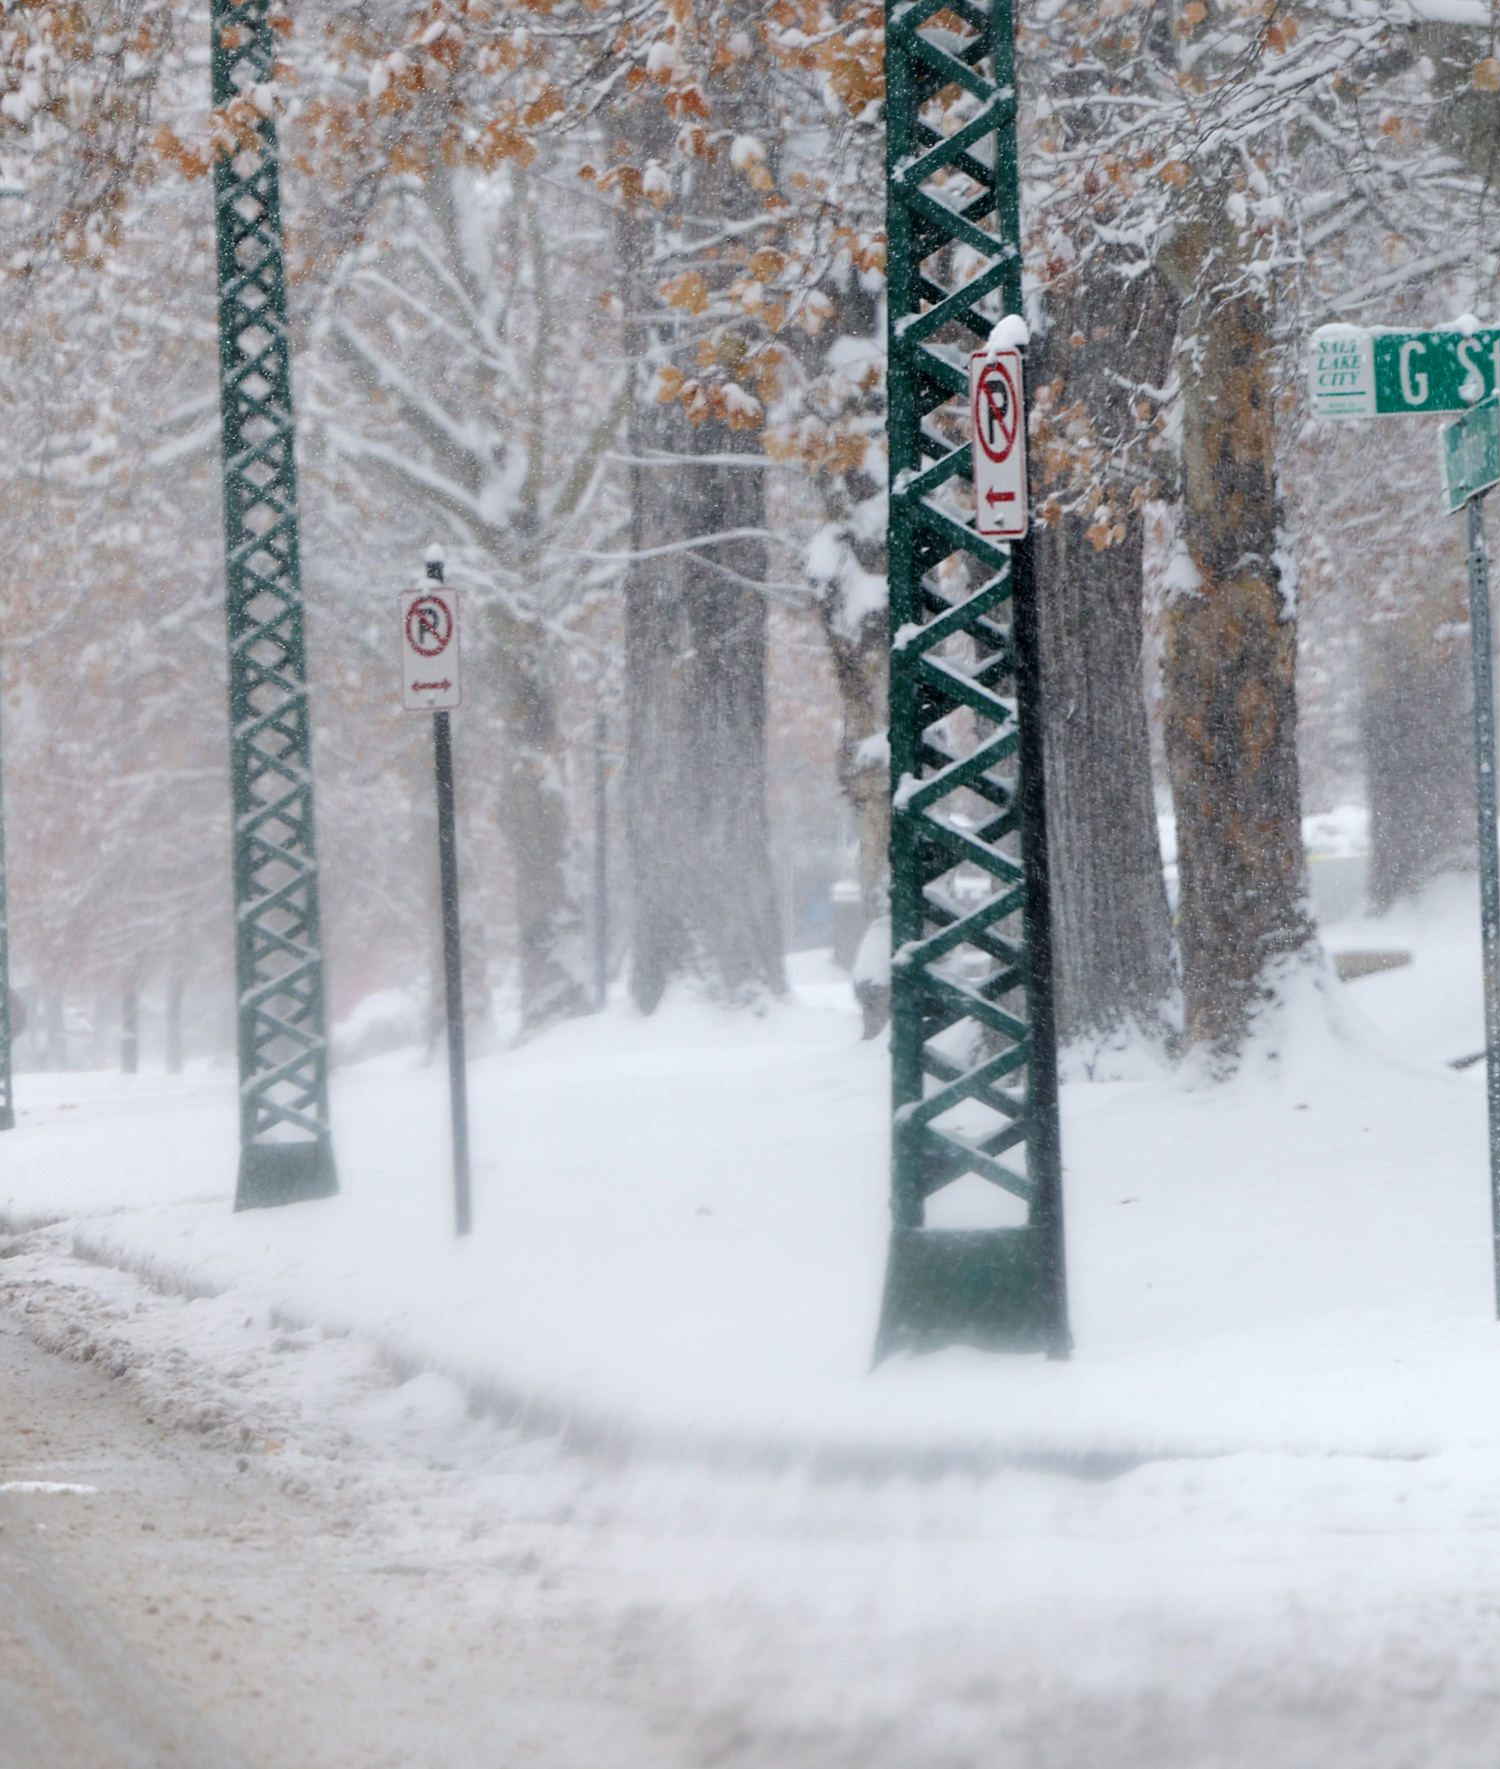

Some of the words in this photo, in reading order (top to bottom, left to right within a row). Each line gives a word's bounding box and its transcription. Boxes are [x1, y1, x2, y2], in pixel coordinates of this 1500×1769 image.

[1317, 354, 1361, 371] LAKE
[1318, 371, 1360, 387] CITY
[1400, 340, 1428, 406] G
